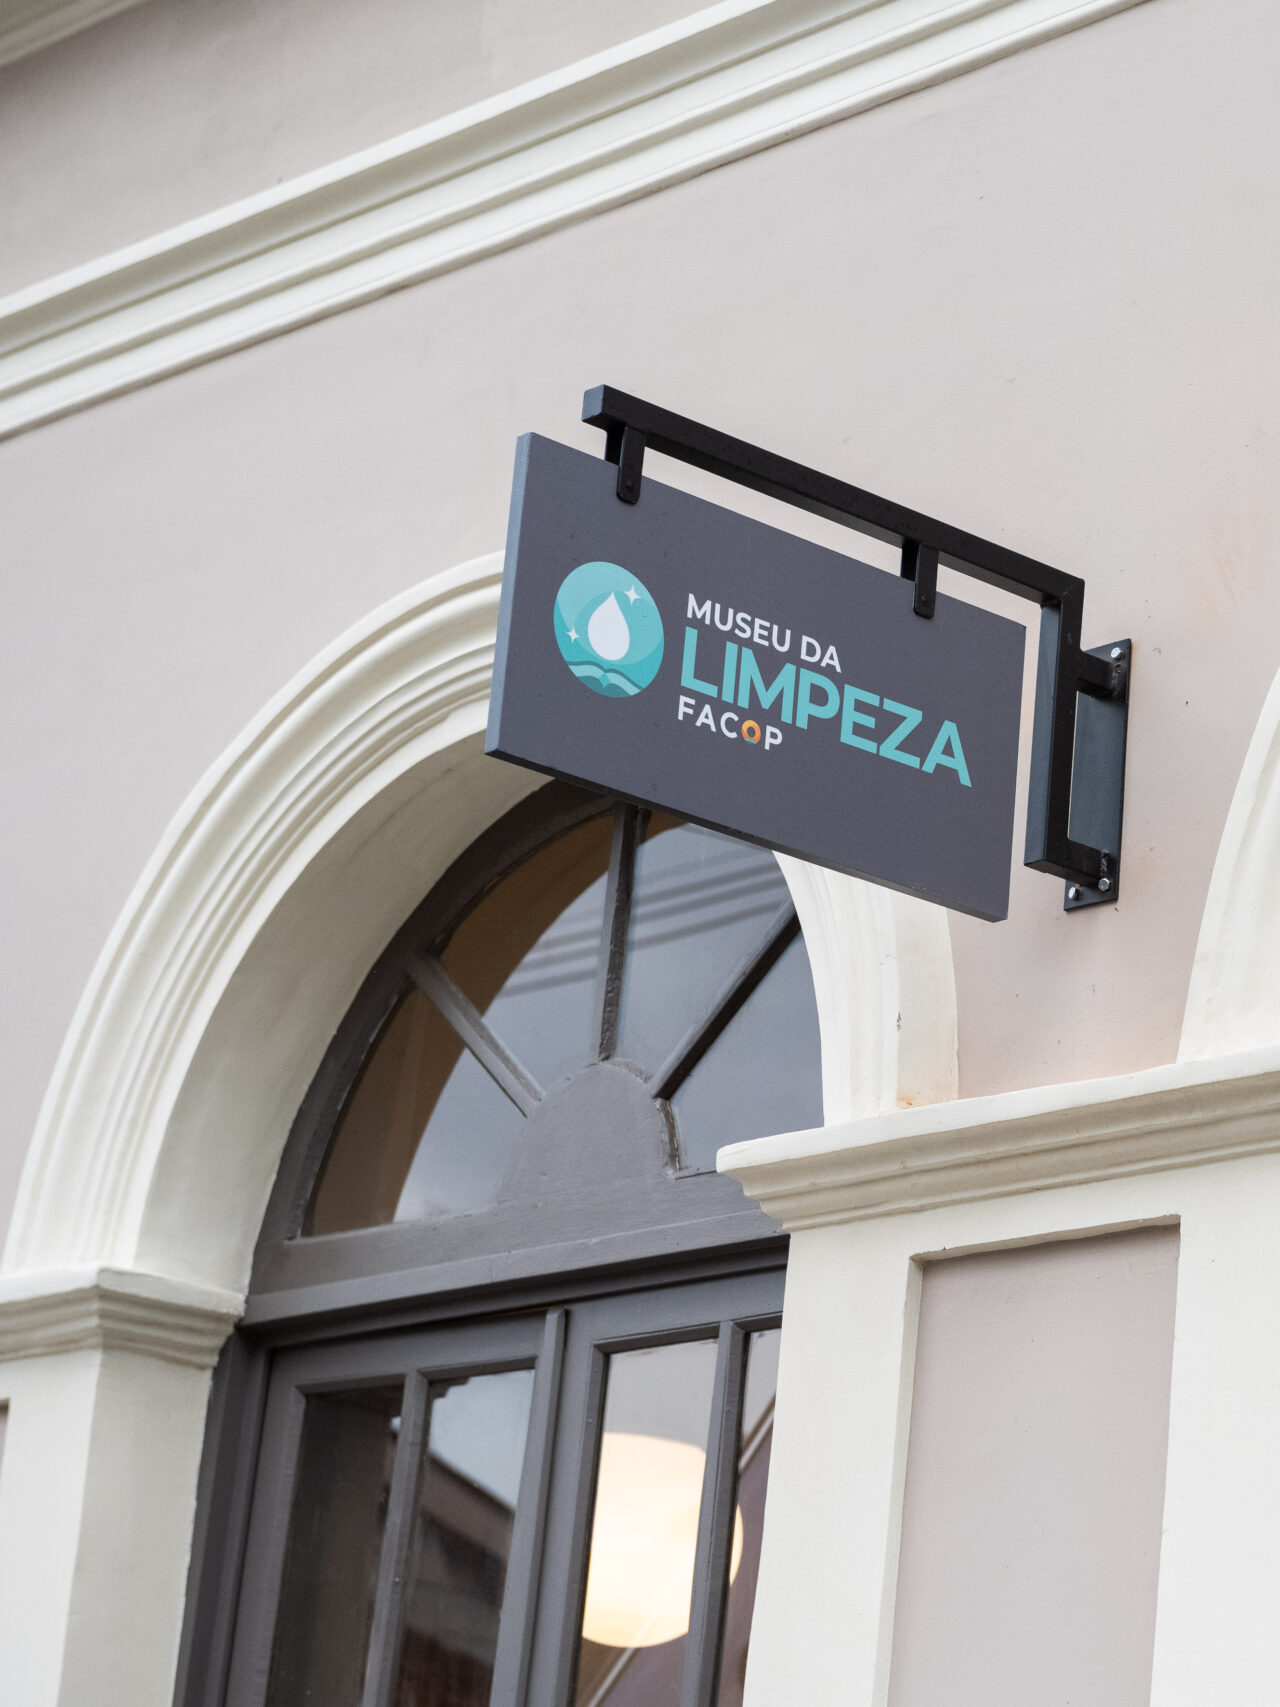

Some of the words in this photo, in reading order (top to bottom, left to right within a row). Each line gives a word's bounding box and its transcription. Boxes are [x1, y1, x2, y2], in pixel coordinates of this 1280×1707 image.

[686, 592, 793, 654] MUSEU
[799, 633, 842, 673] DA
[677, 694, 783, 750] FACOP
[680, 625, 972, 787] LIMPEZA
